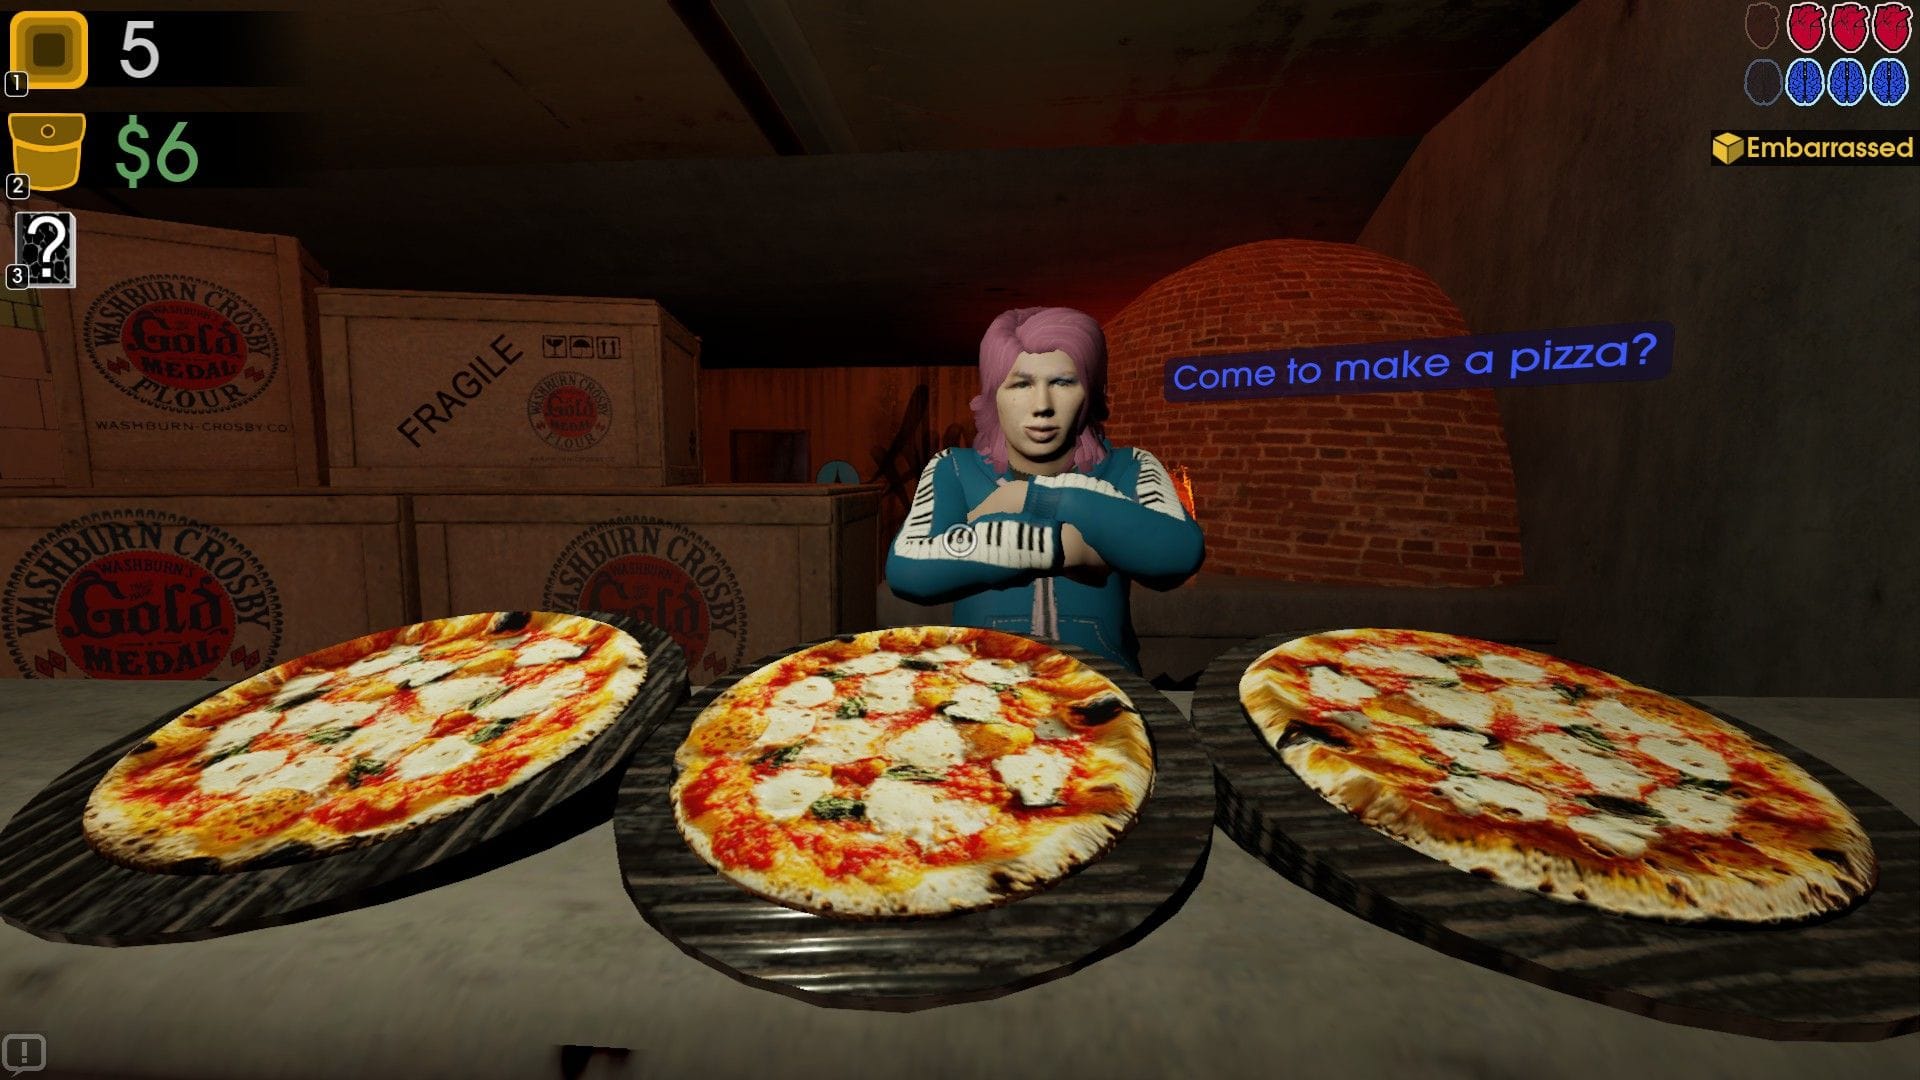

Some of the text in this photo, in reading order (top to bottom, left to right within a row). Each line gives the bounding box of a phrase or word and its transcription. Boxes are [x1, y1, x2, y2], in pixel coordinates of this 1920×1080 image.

[95, 280, 271, 359] WASHBURN CROSBY
[126, 310, 241, 357] Gold
[129, 376, 249, 408] FLOUR
[140, 356, 237, 380] MEDAL
[397, 334, 524, 448] FRAGILE
[17, 520, 271, 636] WASHBURN CROSBY
[62, 571, 230, 640] Gold
[666, 535, 739, 638] CROSBY
[81, 640, 219, 676] MEDAL
